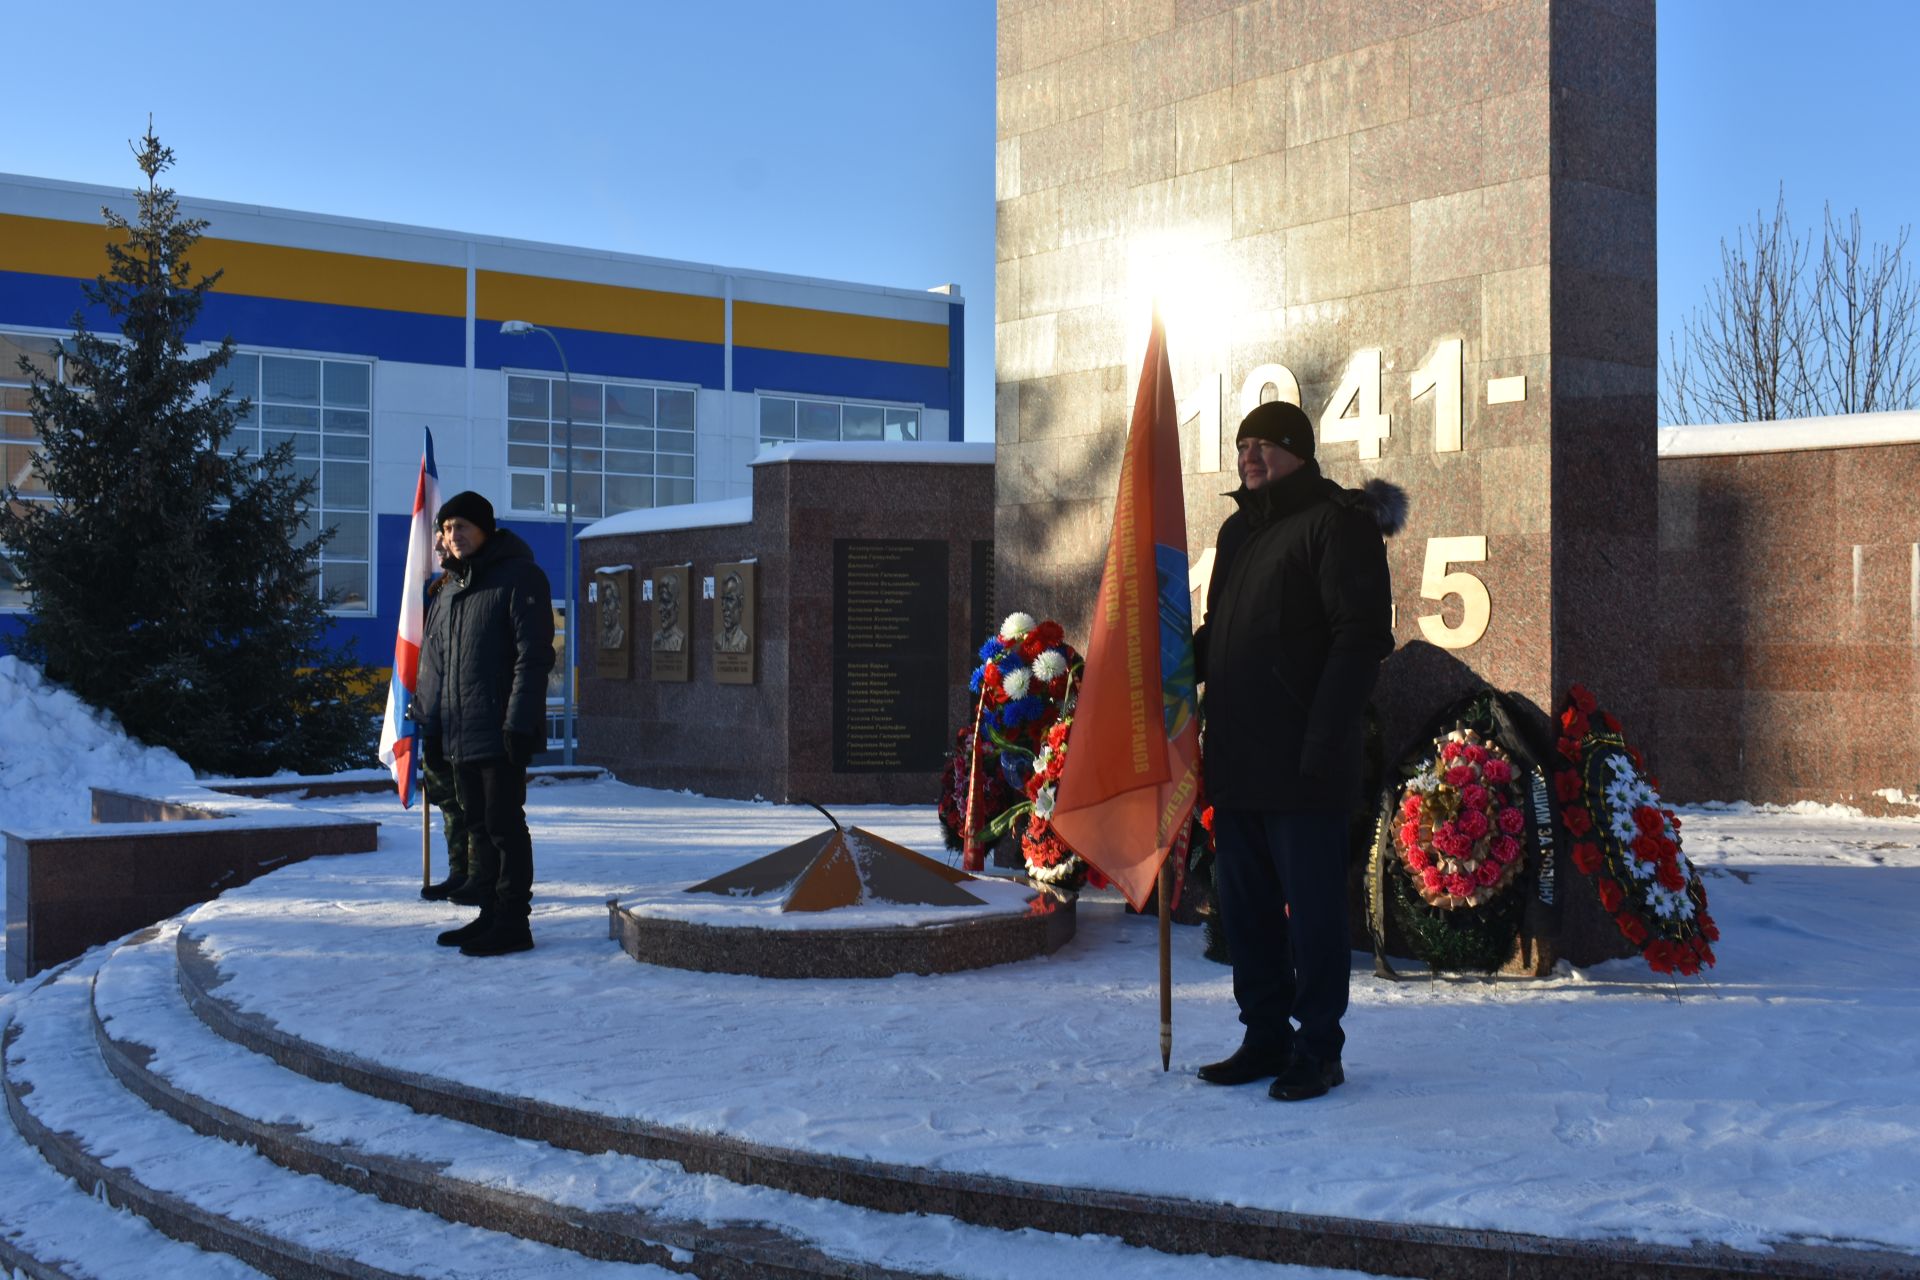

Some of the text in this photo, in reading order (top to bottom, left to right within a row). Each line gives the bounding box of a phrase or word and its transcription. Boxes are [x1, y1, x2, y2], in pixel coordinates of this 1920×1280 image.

[1124, 578, 1144, 687] ОРГАНИЗАЦИЯ
[1130, 689, 1150, 774] ВЕТЕРАНОВ
[1537, 827, 1554, 846] ЗА
